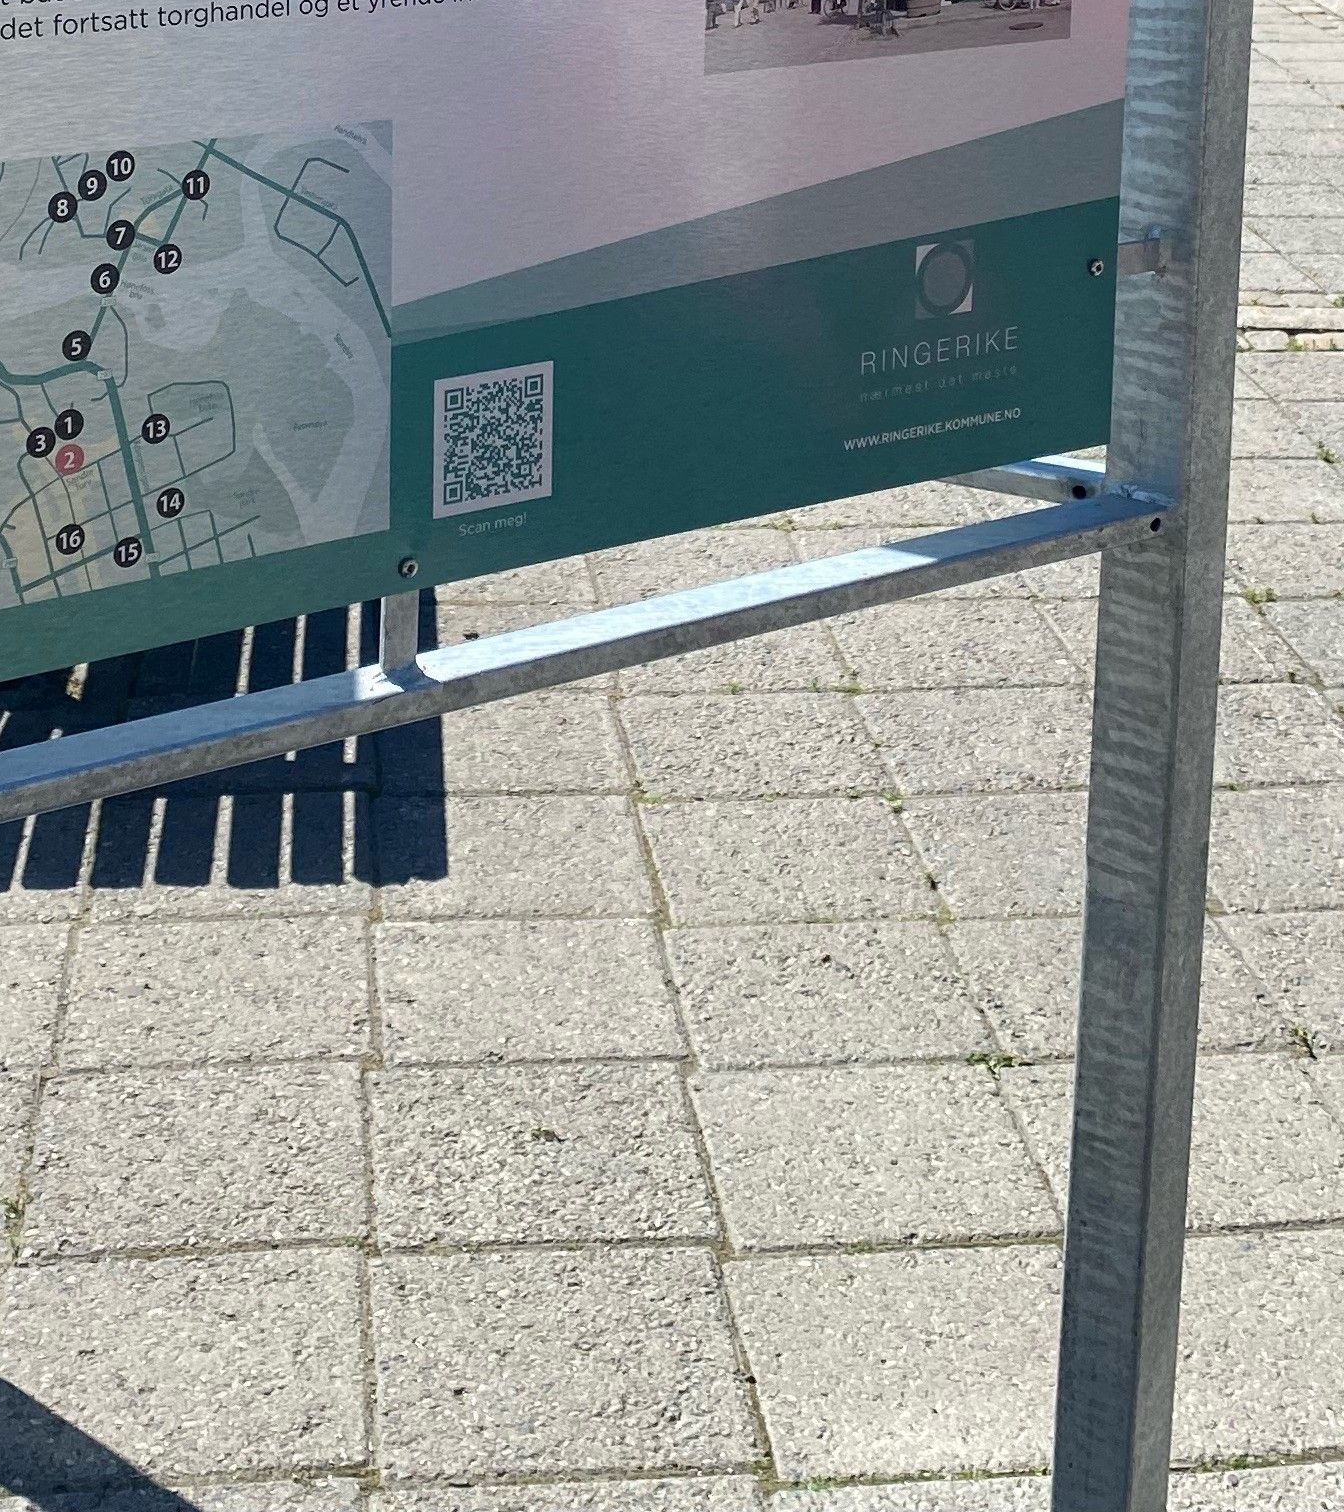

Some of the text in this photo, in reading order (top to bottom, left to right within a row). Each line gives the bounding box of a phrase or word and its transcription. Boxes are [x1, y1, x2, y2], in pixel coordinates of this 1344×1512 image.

[861, 326, 1019, 376] RINGERIKE
[843, 407, 1021, 451] WWW.RINGERIKE.KOMMUNE.NO
[458, 511, 527, 537] Scan meg!
